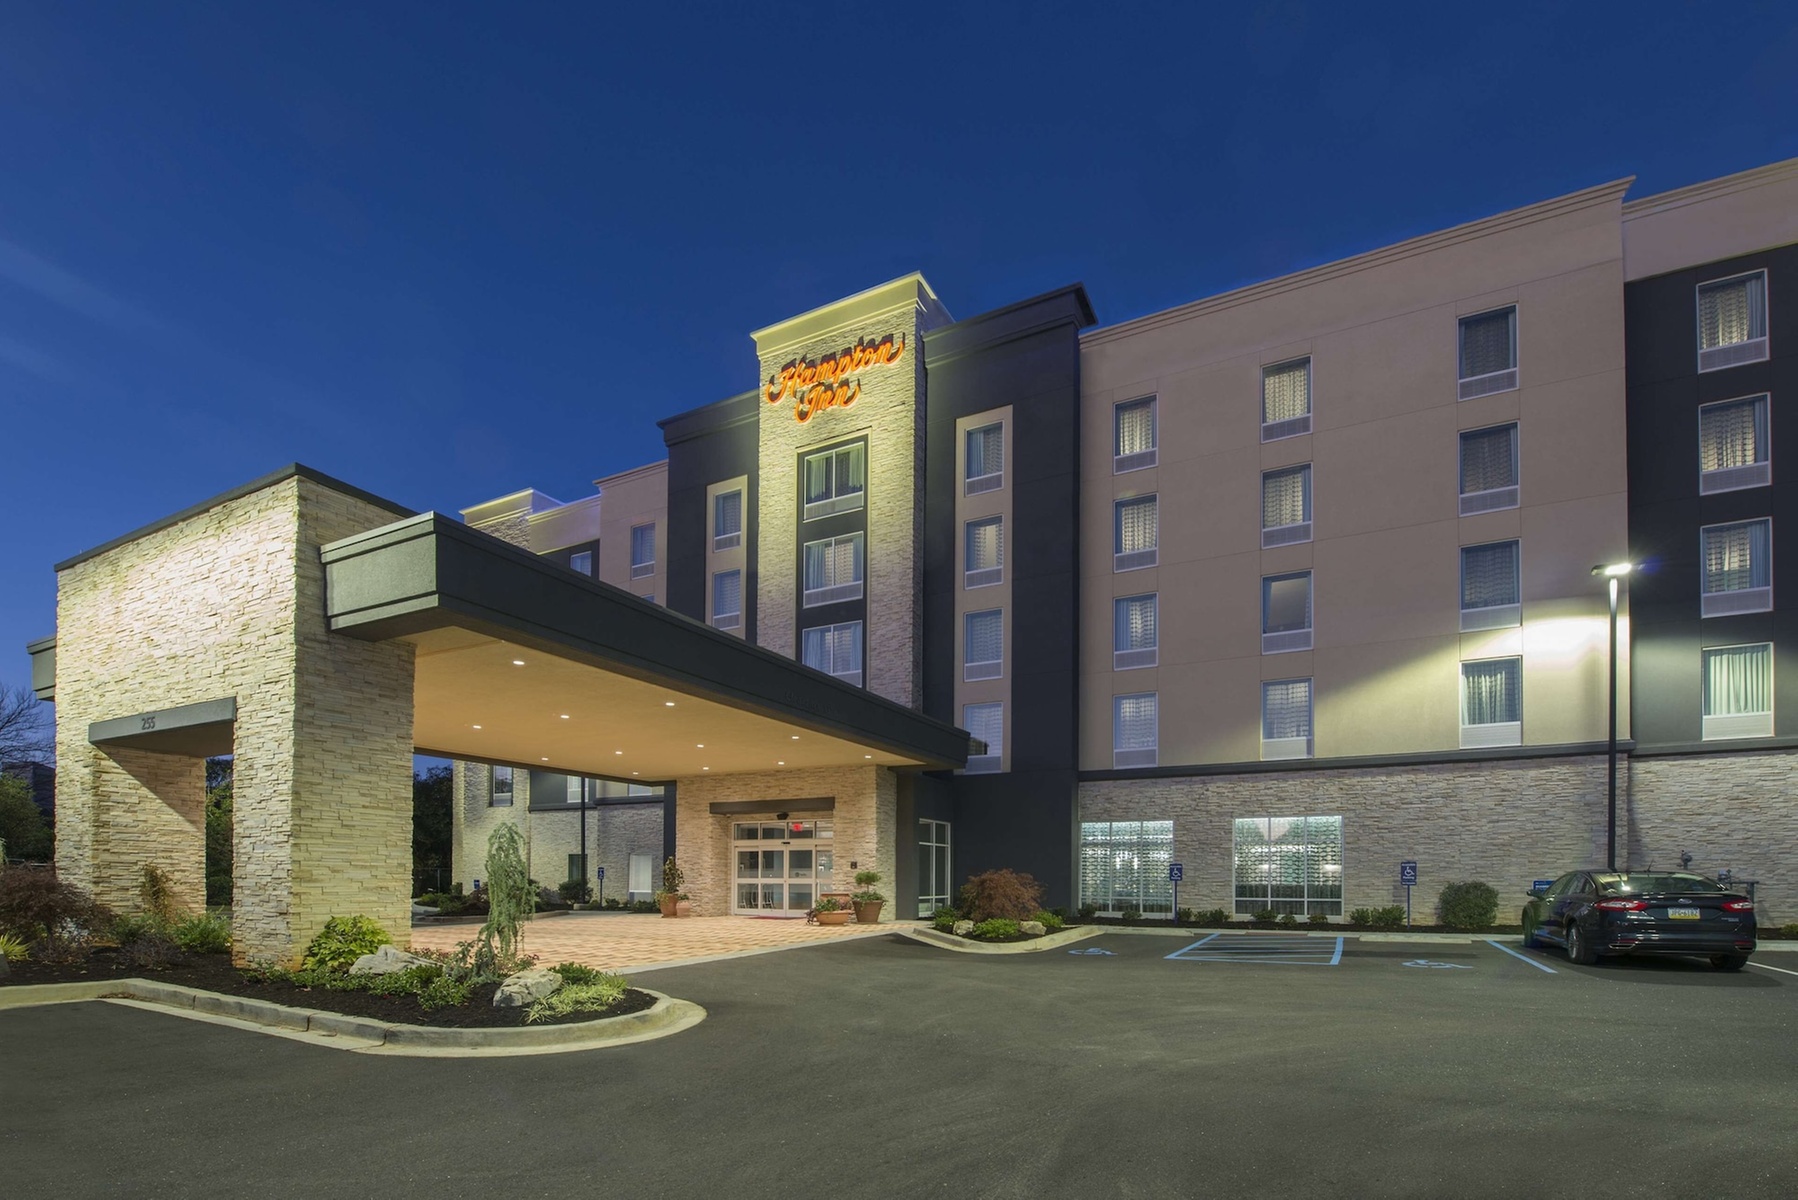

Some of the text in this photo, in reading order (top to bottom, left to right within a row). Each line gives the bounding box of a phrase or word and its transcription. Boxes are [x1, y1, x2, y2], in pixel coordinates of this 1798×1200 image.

[765, 338, 905, 404] Hampton
[794, 382, 862, 424] Inn
[141, 716, 155, 730] 255
